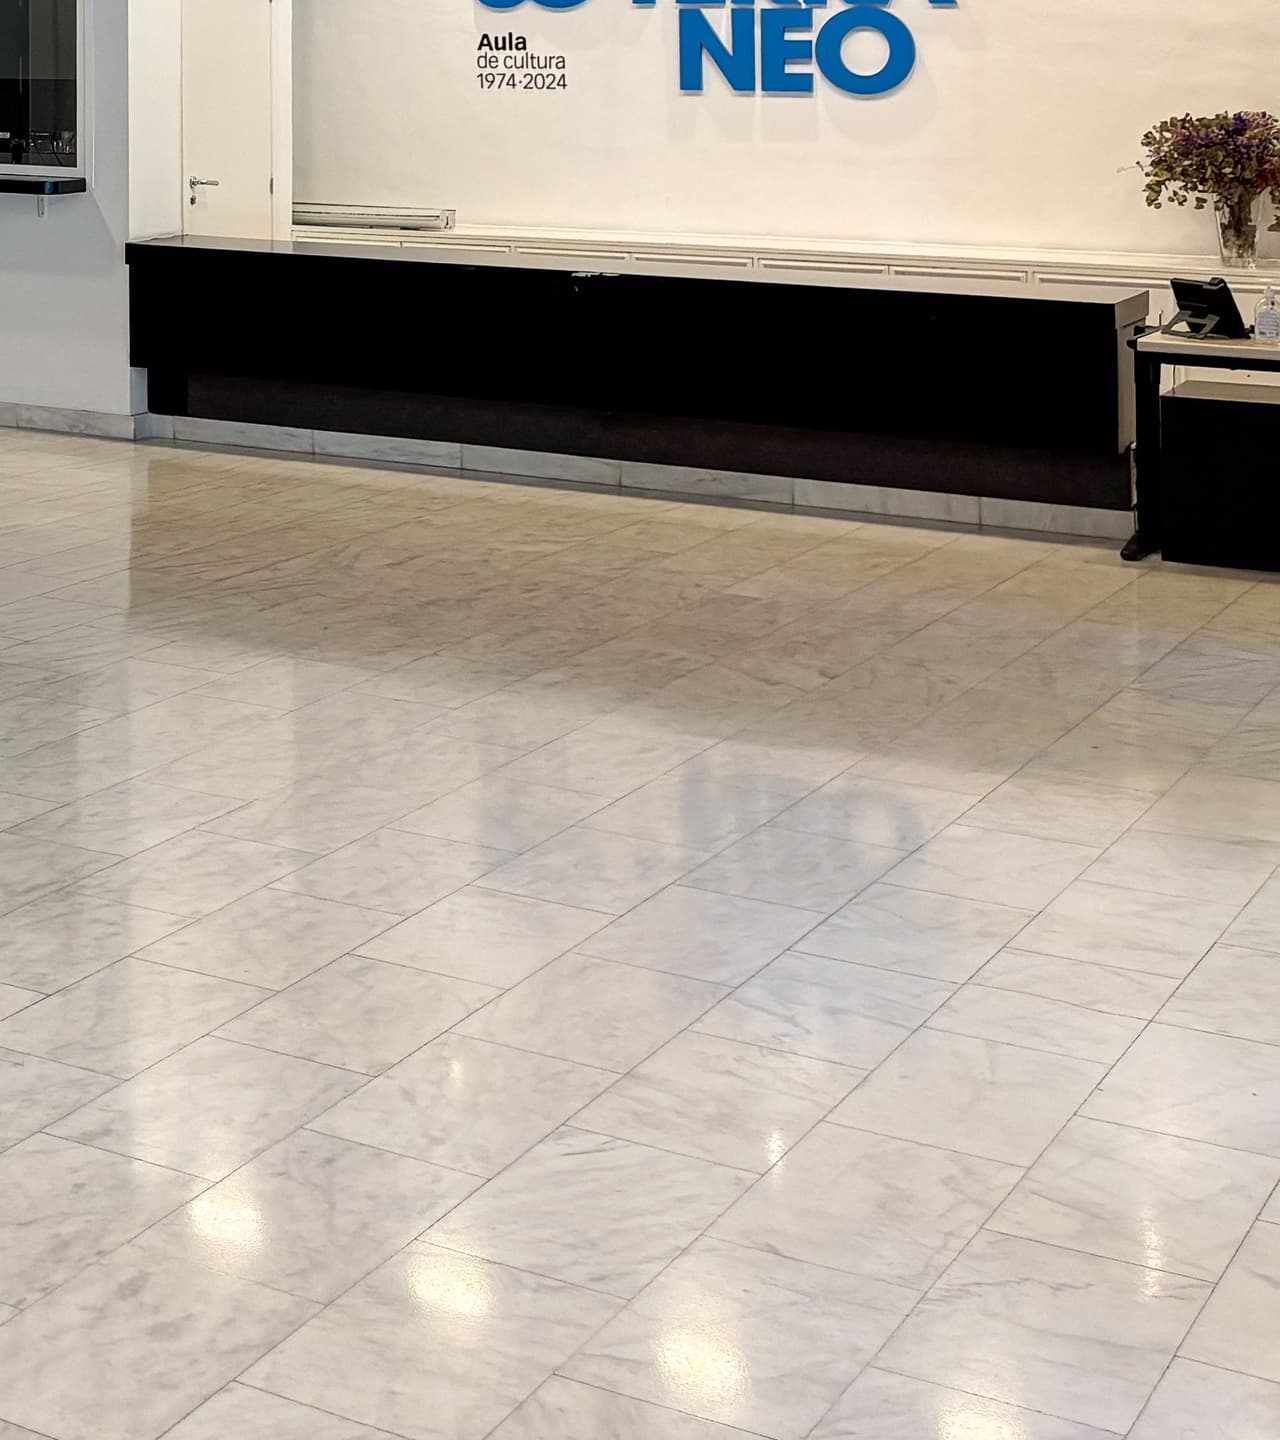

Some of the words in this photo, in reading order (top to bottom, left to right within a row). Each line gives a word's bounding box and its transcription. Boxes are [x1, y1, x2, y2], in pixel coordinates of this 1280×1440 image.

[477, 32, 527, 51] Aula
[678, 5, 916, 95] NEO
[477, 52, 499, 69] de
[503, 52, 566, 70] cultura
